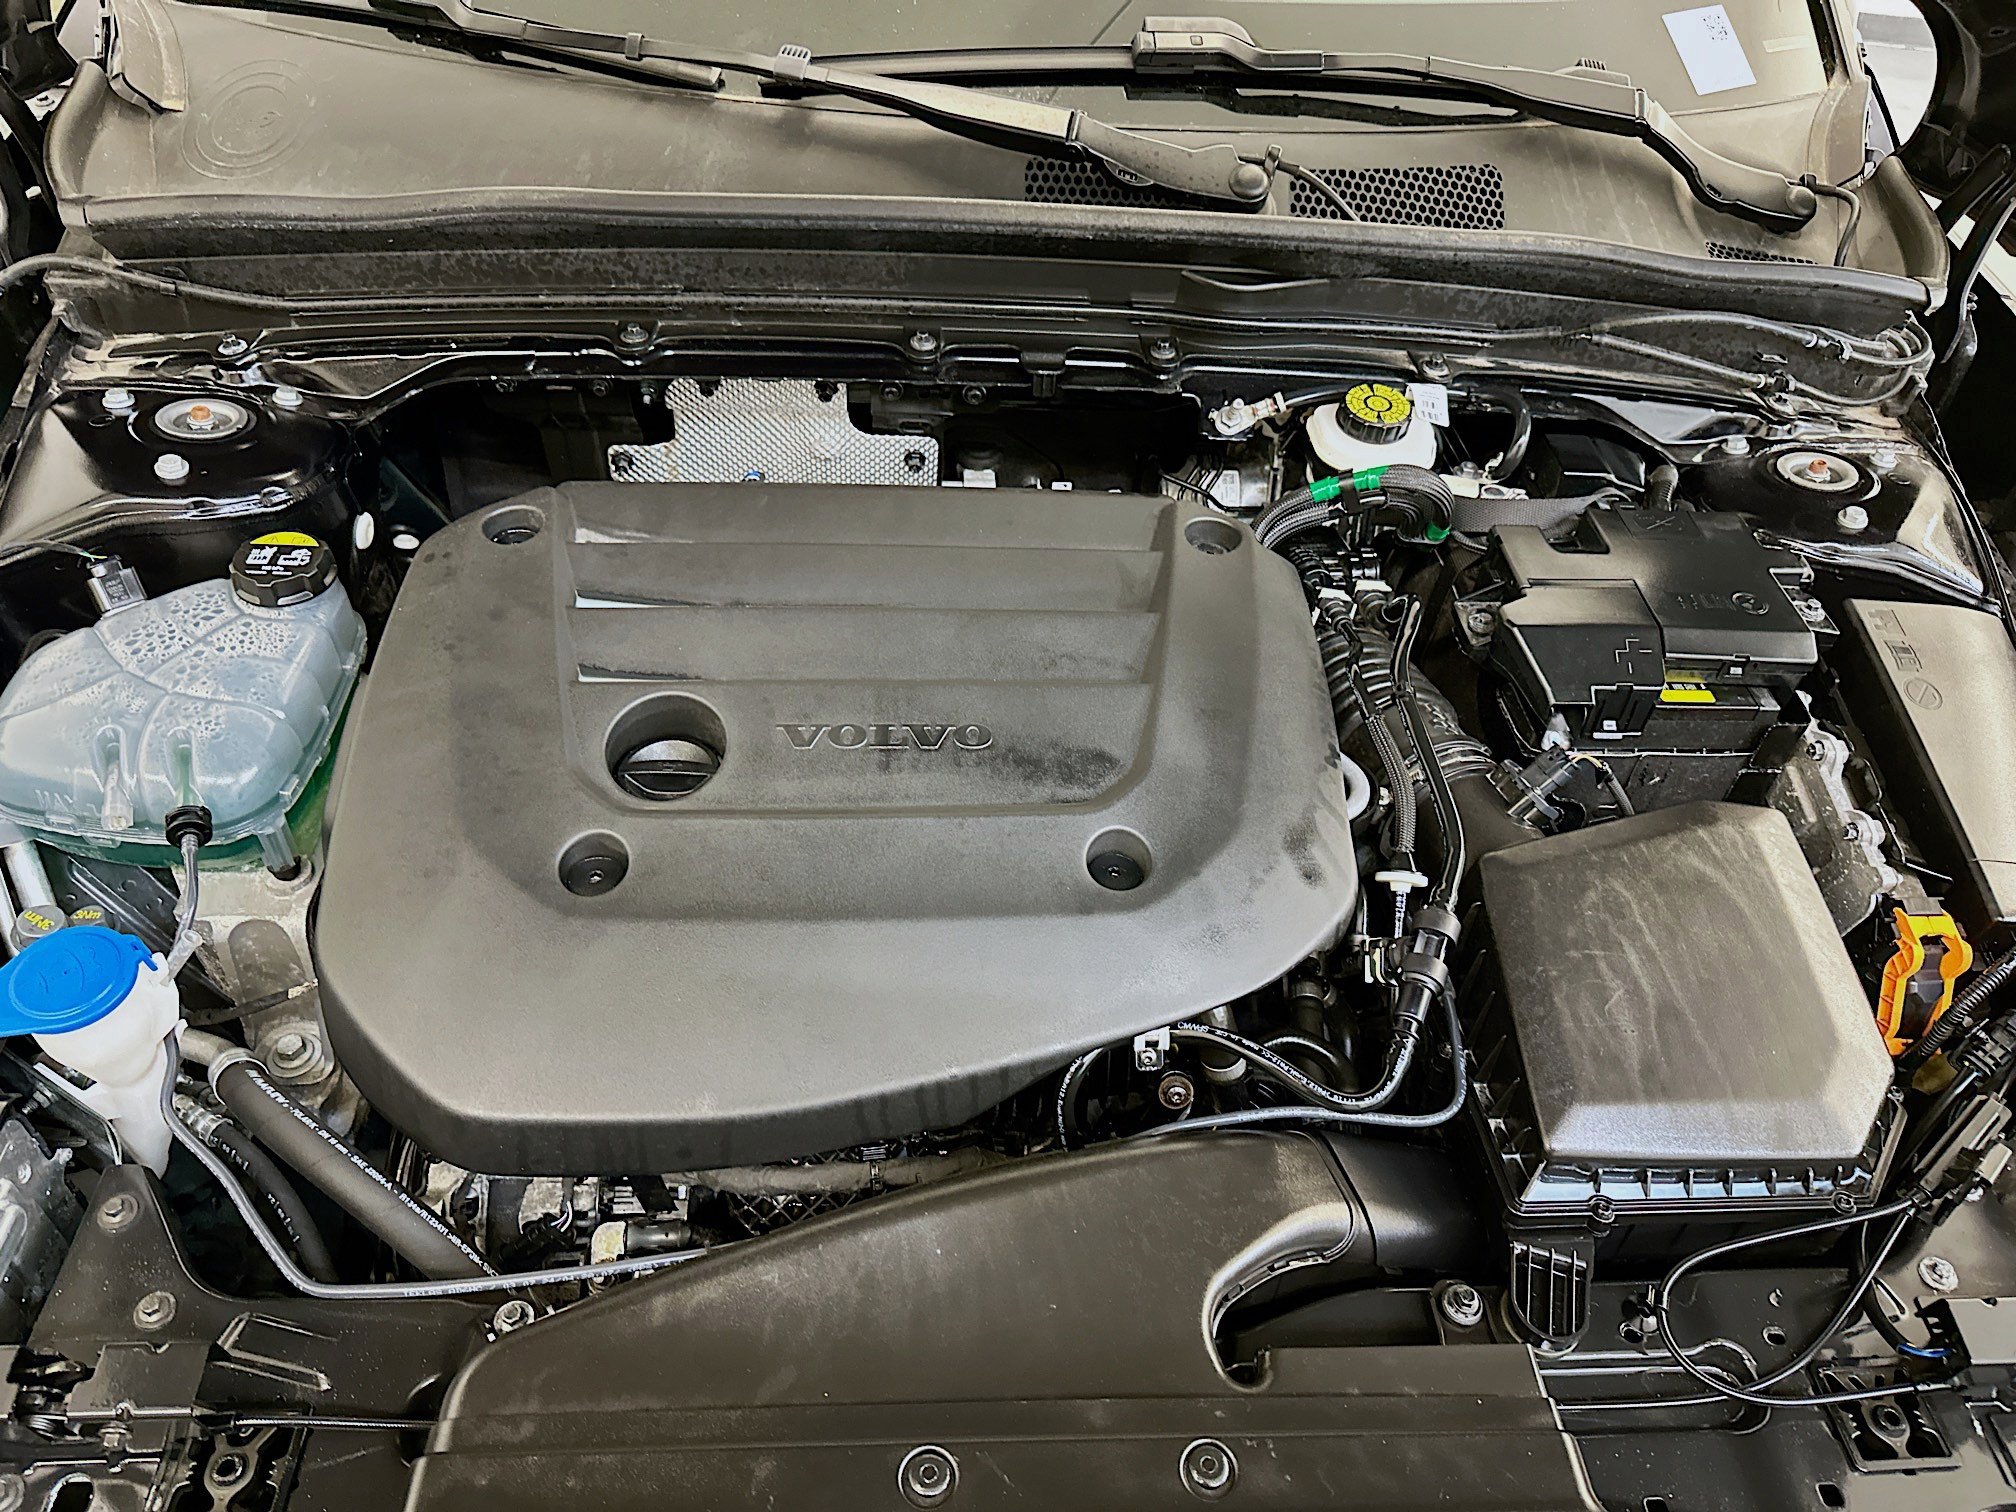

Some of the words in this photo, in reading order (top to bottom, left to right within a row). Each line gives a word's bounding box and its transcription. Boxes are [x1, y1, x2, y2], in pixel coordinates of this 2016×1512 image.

[776, 724, 993, 750] VOLVO
[24, 911, 54, 930] 3Nm
[73, 910, 101, 919] 3Nm
[350, 1154, 369, 1170] SAE
